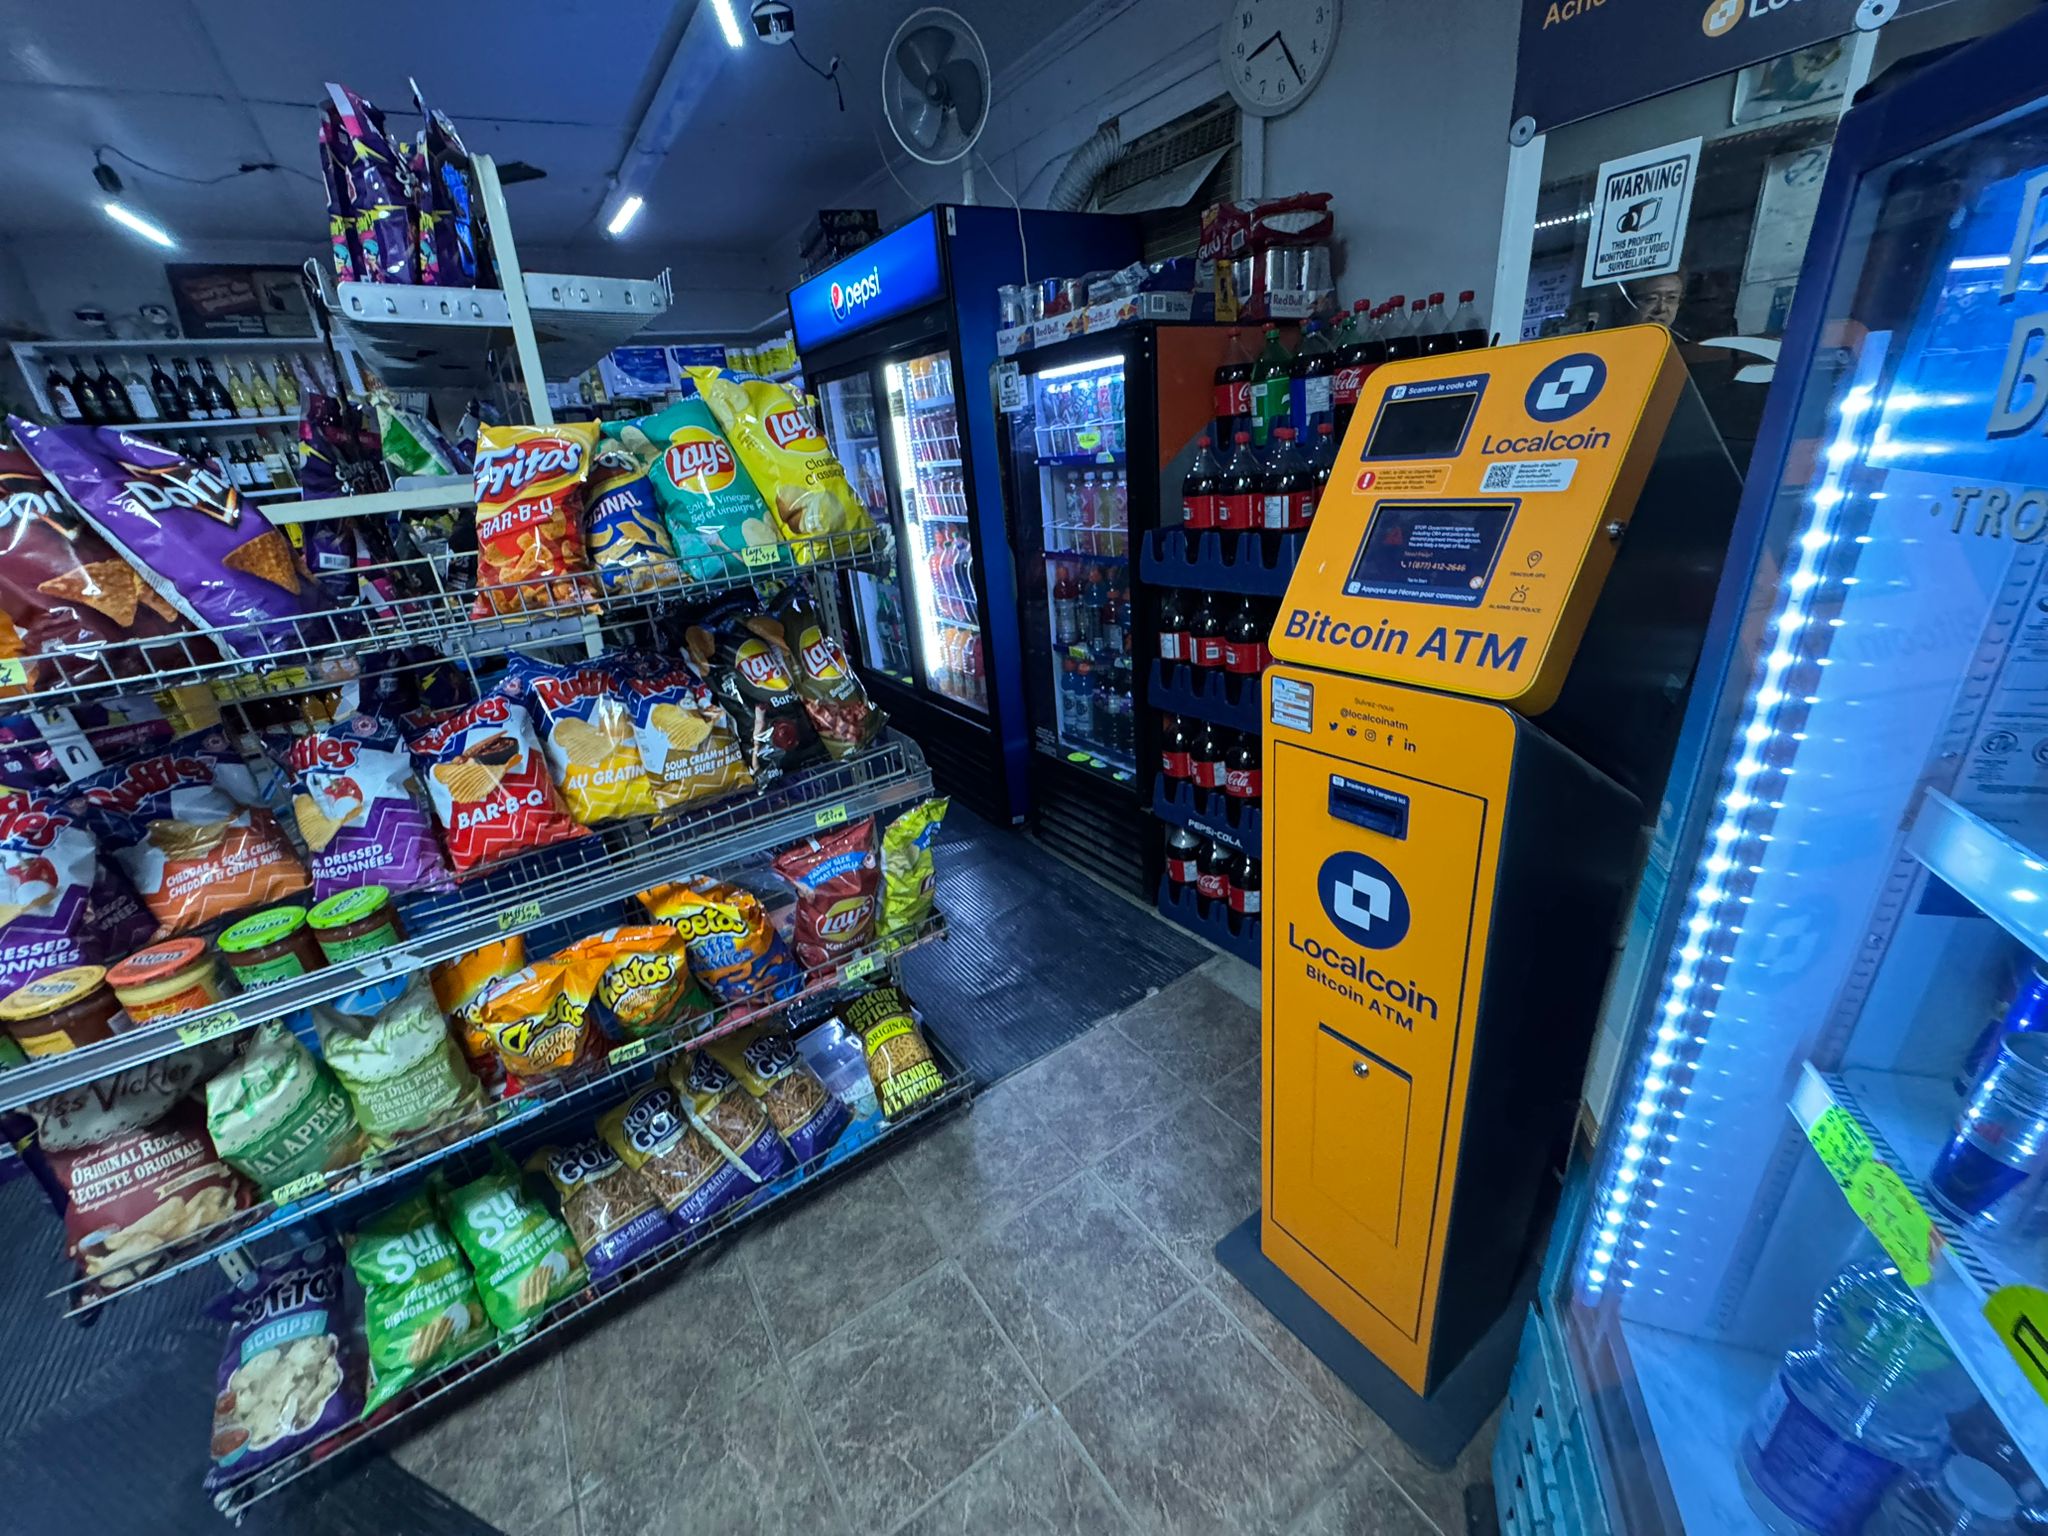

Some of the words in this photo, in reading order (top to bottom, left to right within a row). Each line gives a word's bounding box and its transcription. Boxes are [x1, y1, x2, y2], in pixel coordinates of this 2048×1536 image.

[1611, 163, 1683, 202] WARNING
[1600, 248, 1637, 264] MONITORED
[1638, 245, 1648, 256] BY
[1649, 241, 1670, 253] VIDEO
[1612, 239, 1627, 251] THIS
[1628, 232, 1663, 248] PROPERTY
[1608, 254, 1658, 272] SURVEILLANCE
[845, 265, 880, 315] pepsi
[1408, 385, 1437, 395] Scanner
[1446, 380, 1464, 389] code
[1465, 379, 1478, 388] QR
[770, 410, 818, 444] Lay
[1481, 427, 1611, 454] Localcoin
[473, 442, 583, 503] Fritos
[670, 439, 730, 481] Lay's
[716, 493, 750, 506] Vinegar
[717, 503, 756, 517] vinaigre
[1435, 592, 1477, 601] commencer
[1284, 608, 1409, 655] Bitcoin
[1416, 626, 1529, 672] ATM
[741, 653, 783, 681] Lay
[1340, 707, 1409, 731] @localcoinatm
[664, 758, 688, 771] SOUR
[689, 751, 719, 766] CREAM
[694, 761, 716, 776] SURE
[567, 773, 588, 790] AU
[593, 763, 646, 785] GRATIN
[457, 789, 544, 830] BAR-B-Q
[1188, 818, 1242, 848] PEPSI-COLA
[166, 862, 210, 887] CHEDDAR
[222, 848, 248, 864] SOUR
[324, 844, 384, 867] DRESSED
[808, 861, 833, 880] FAMILY
[833, 854, 850, 864] SIZE
[832, 861, 860, 876] FAMILIA
[0, 938, 72, 961] ESSED
[1288, 921, 1438, 1021] Localcoin
[846, 987, 899, 1024] HICKORY
[1306, 962, 1365, 1009] Bitcoin
[1367, 999, 1415, 1033] ATM
[853, 1001, 903, 1033] STICKS
[881, 1059, 938, 1097] JULIENNES
[622, 1090, 672, 1134] ROLD
[71, 1150, 141, 1186] ORIGINAL
[500, 1234, 537, 1266] FRENCH
[404, 1278, 444, 1308] FRENCH
[245, 1315, 319, 1353] SCOOPS!
